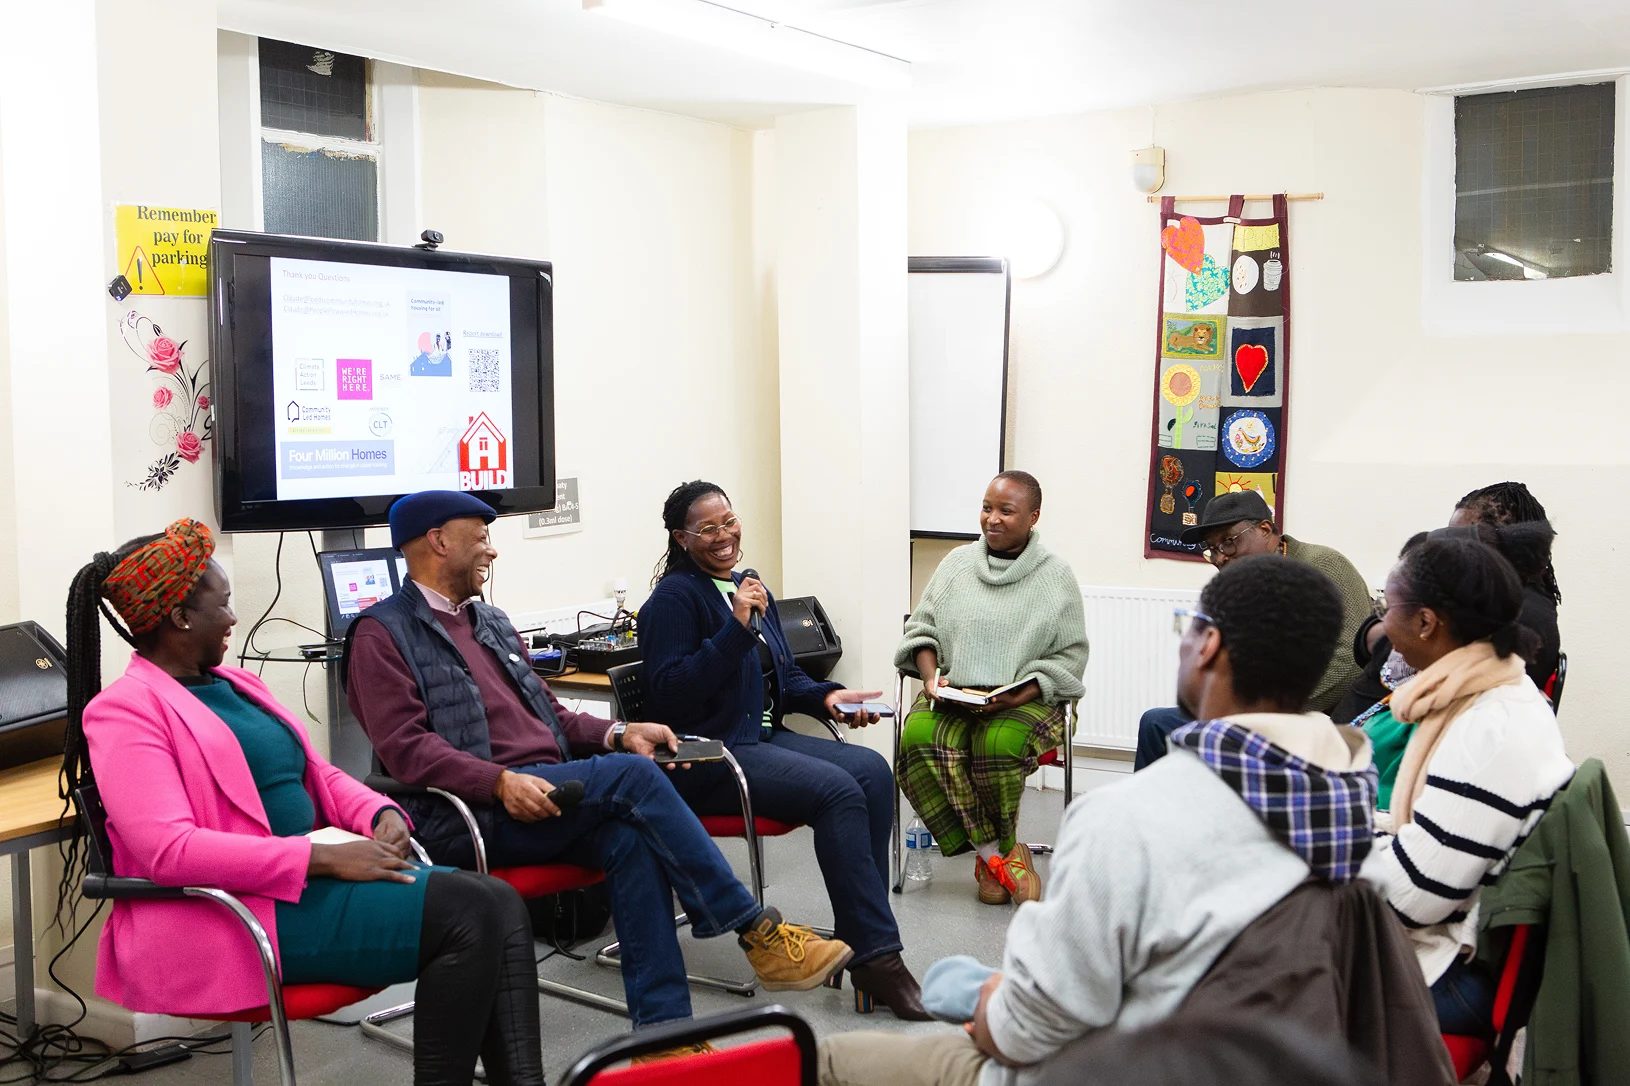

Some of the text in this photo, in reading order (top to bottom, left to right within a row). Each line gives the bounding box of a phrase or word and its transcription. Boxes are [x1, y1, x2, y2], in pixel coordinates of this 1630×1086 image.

[137, 205, 216, 224] Remember
[153, 229, 203, 246] pay for
[152, 250, 207, 269] parking
[282, 270, 302, 279] Thank
[318, 272, 350, 282] Questions
[342, 368, 366, 376] WE'RE
[373, 421, 388, 429] CLT
[289, 448, 387, 462] Four Million Homes
[460, 471, 507, 491] BUILD
[539, 514, 572, 526] (0.3ml dose)
